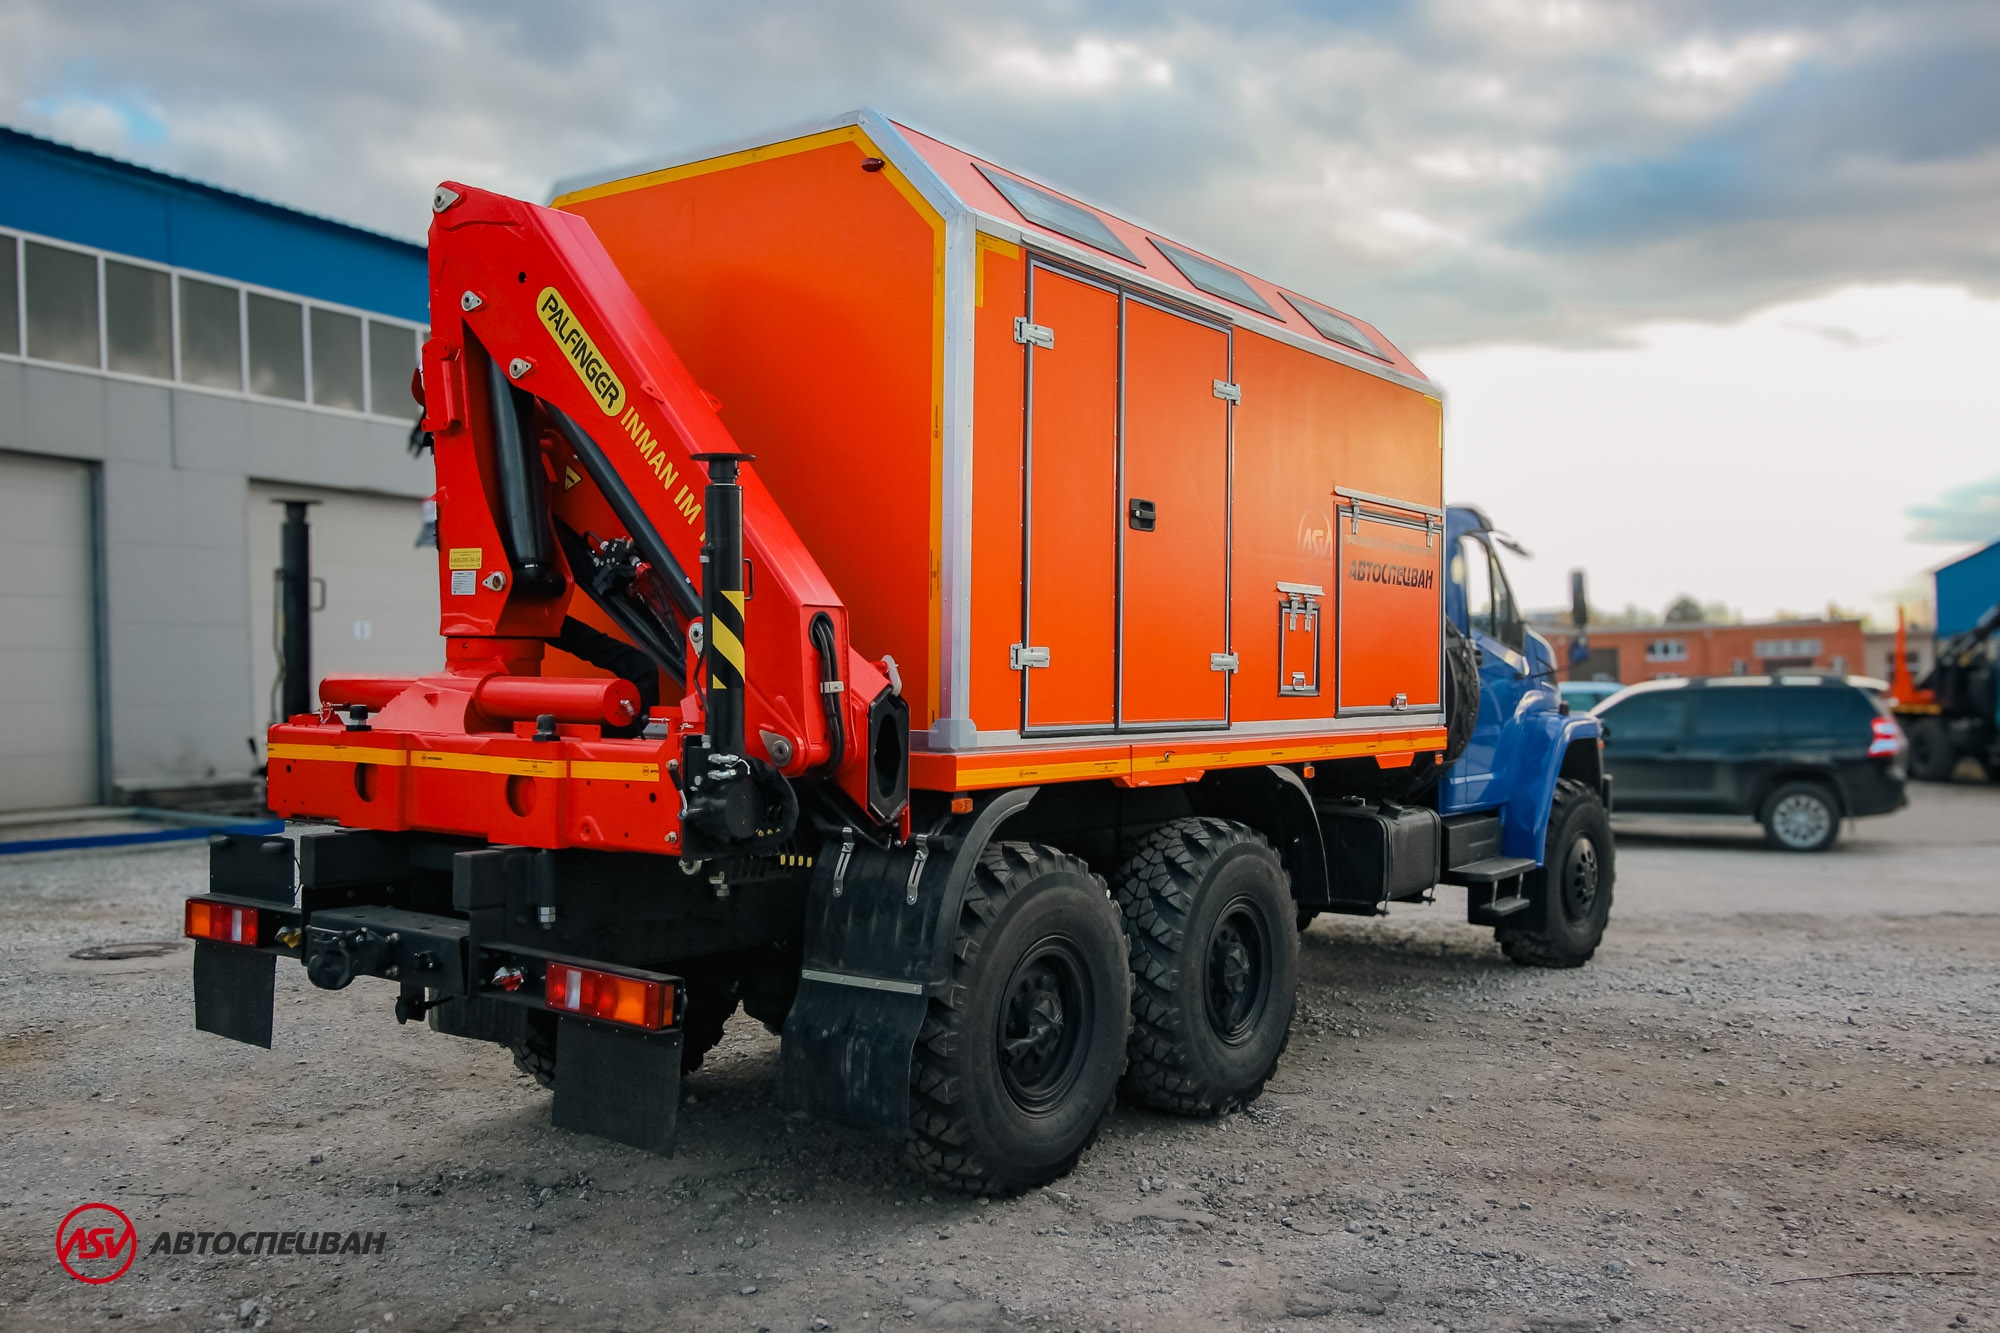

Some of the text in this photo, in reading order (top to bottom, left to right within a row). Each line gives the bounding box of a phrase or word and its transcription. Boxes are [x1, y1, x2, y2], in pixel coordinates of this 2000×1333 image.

[541, 293, 620, 409] PALFINGER
[620, 406, 702, 526] INMAN IM
[1348, 560, 1433, 590] АВТОСПЕЦВАН
